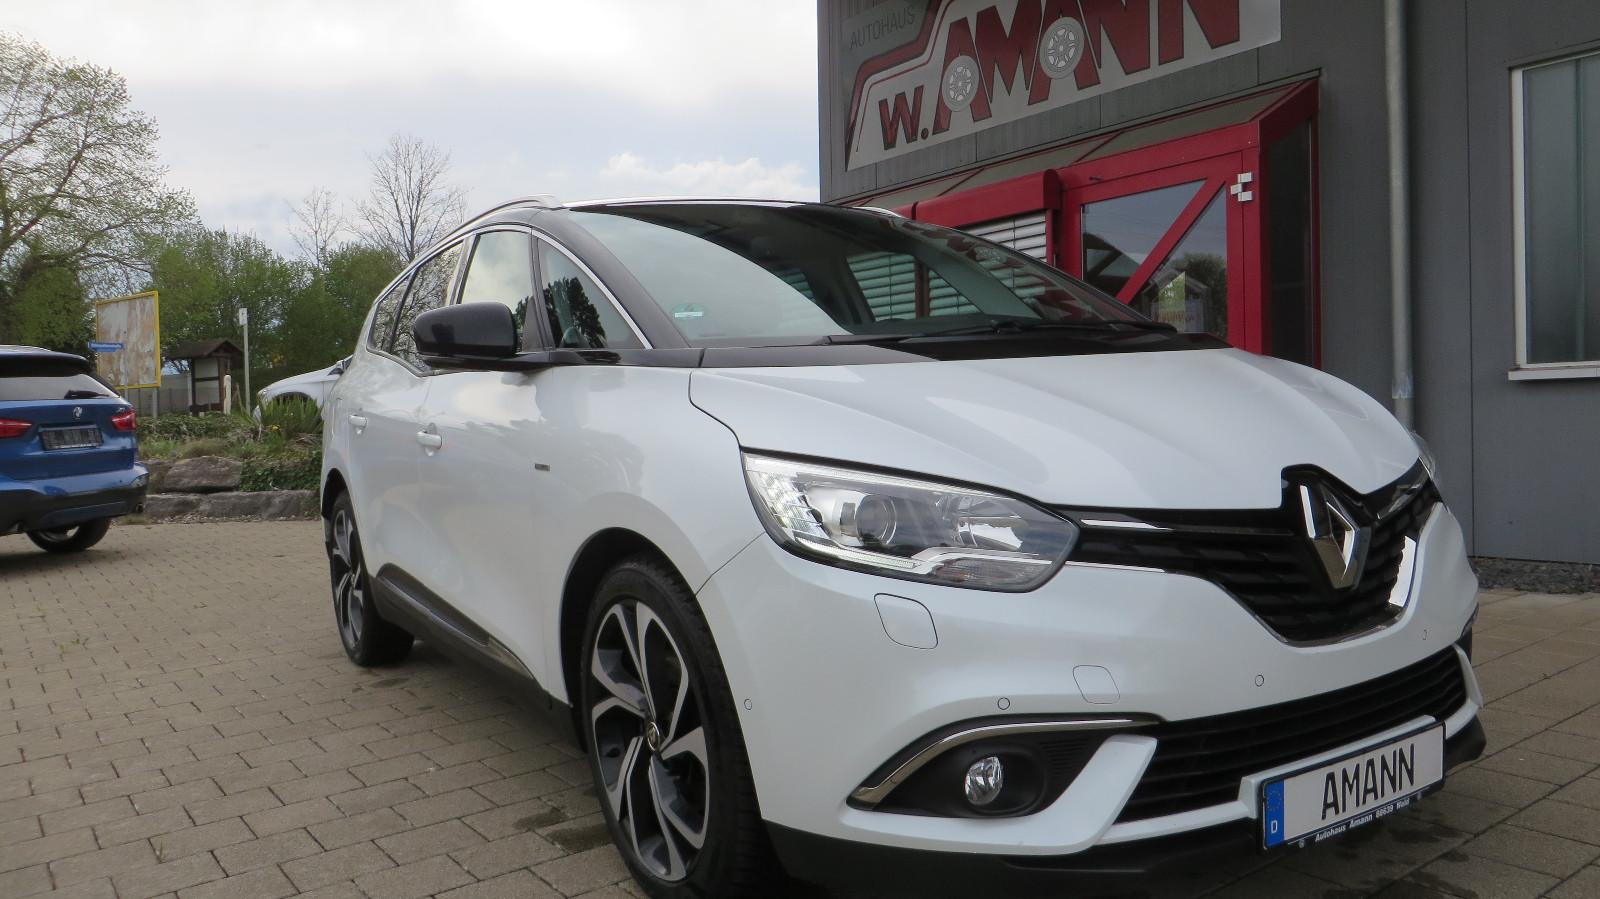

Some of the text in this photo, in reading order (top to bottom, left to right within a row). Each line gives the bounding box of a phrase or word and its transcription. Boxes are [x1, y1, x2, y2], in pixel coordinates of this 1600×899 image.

[849, 5, 915, 50] AUTOHAUS
[1270, 743, 1415, 834] D AMANN
[1315, 824, 1346, 842] Autohaus
[1349, 813, 1373, 828] Amann
